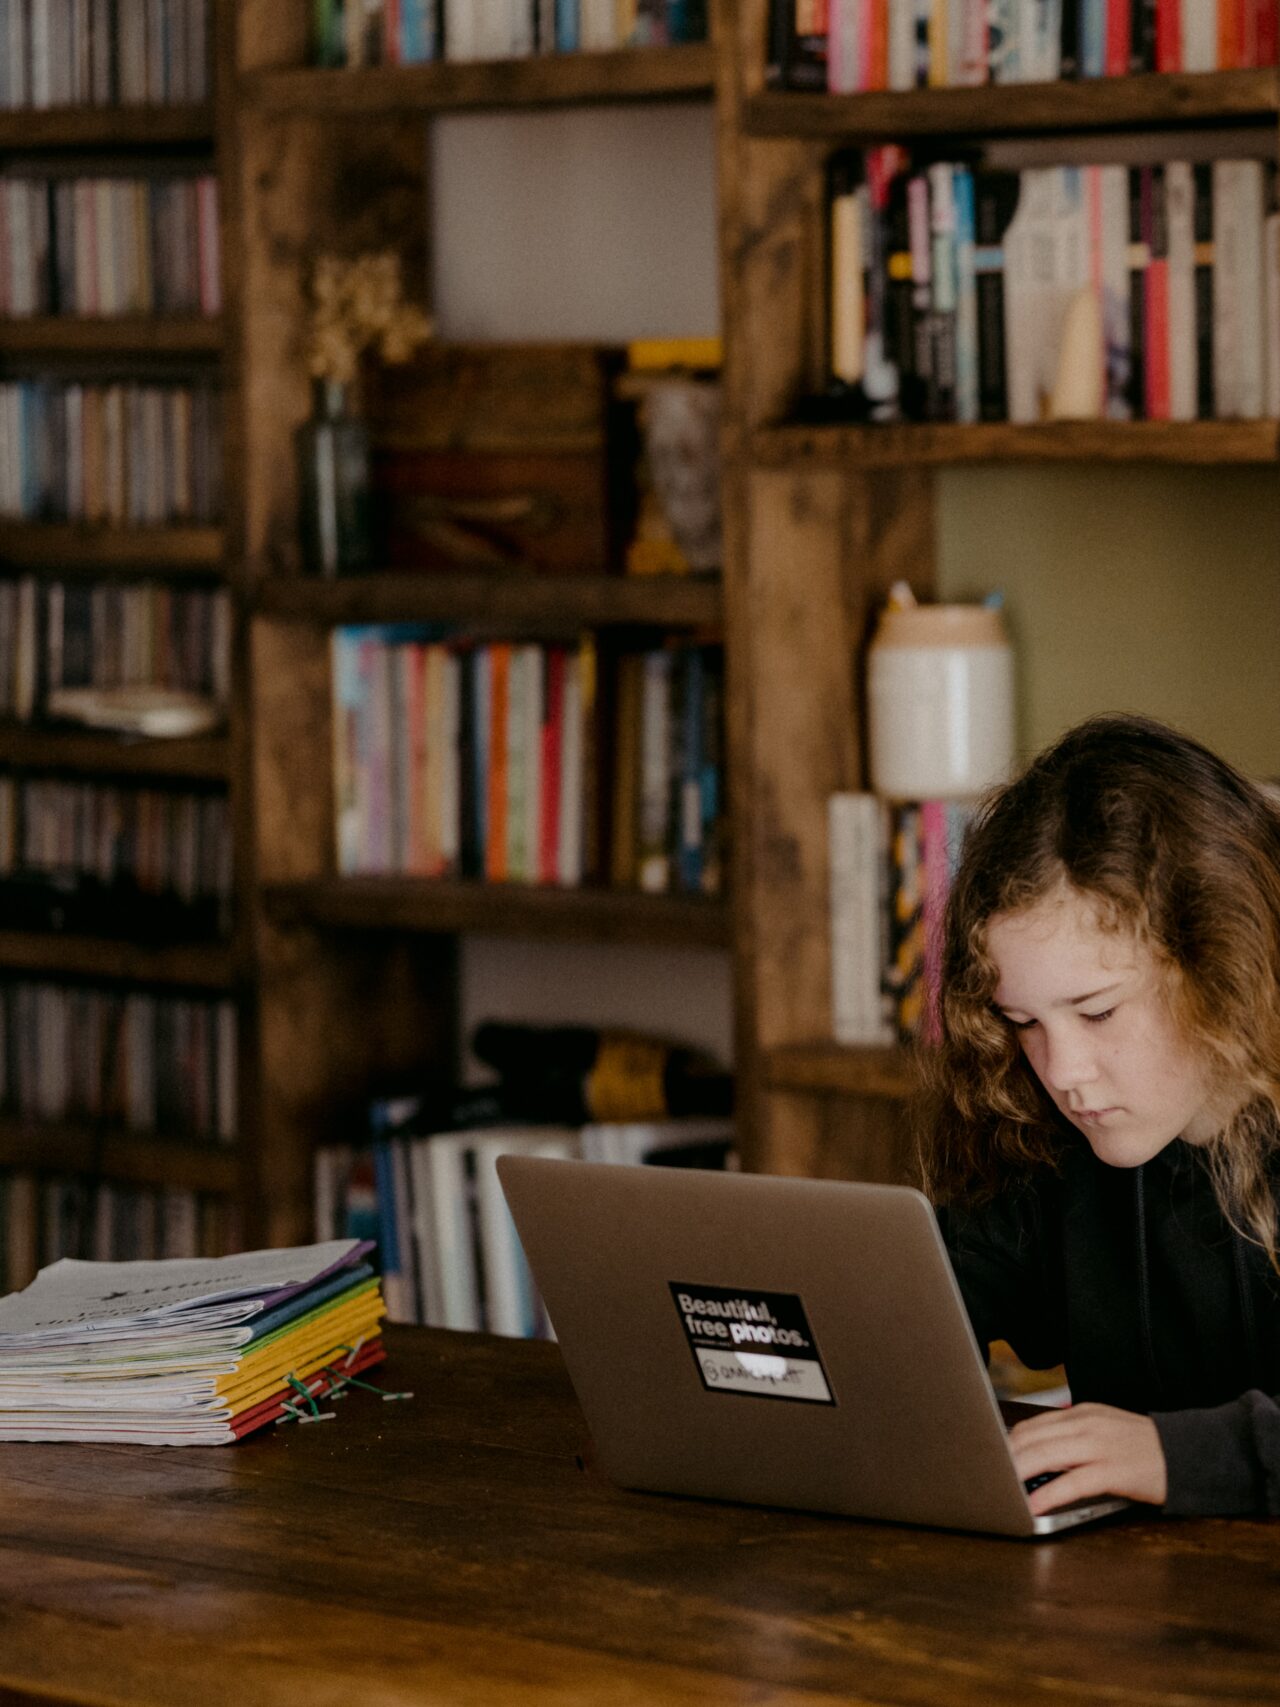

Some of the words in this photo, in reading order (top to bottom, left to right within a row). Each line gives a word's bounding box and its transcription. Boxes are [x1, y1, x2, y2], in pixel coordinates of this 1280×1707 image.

[677, 1293, 778, 1326] Beautiful,
[686, 1316, 729, 1338] free
[729, 1322, 811, 1348] photos.
